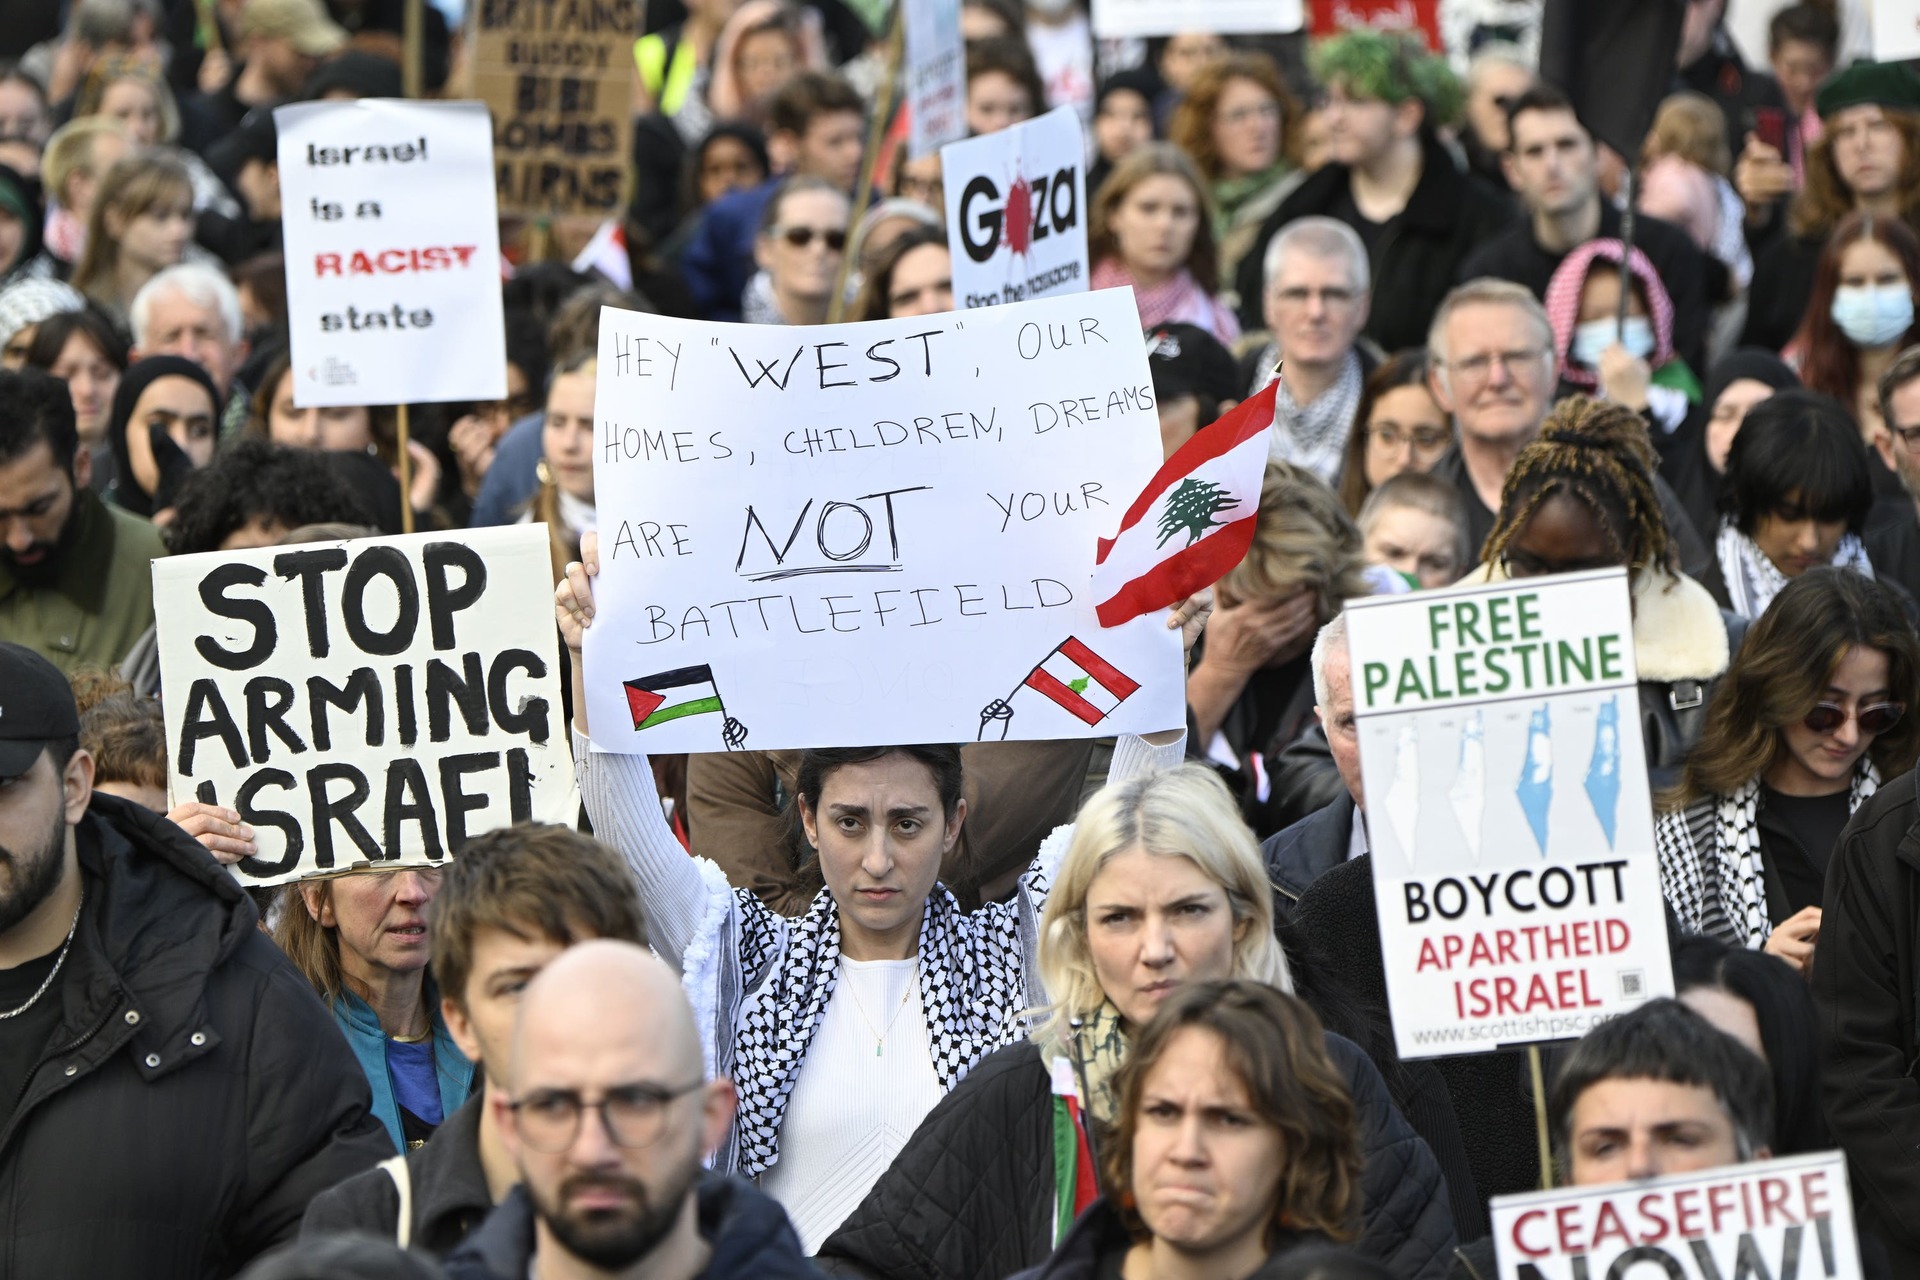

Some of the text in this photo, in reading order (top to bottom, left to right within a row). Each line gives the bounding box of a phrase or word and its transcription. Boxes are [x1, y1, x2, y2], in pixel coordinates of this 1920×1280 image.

[307, 137, 427, 167] Israel
[493, 120, 616, 155] OMBS
[311, 198, 382, 221] is a
[315, 246, 476, 277] RACIST
[1003, 281, 1026, 304] the
[320, 304, 434, 332] state
[614, 331, 681, 391] HEY
[1017, 317, 1109, 360] OUR
[605, 385, 1156, 466] HOMES, CHILDREN, DREAMS
[612, 481, 1110, 573] ARE NOT YOUR
[193, 541, 488, 671] STOP
[636, 577, 1073, 645] BATTLEFIELD
[1428, 593, 1543, 650] FREE
[1363, 633, 1624, 707] PALESTINE
[177, 648, 550, 777] ARMING
[196, 747, 535, 878] SRAE
[1404, 860, 1628, 925] BOYCOTT
[1416, 918, 1631, 974] APARTHEID
[1453, 968, 1602, 1020] ISRAEL
[1511, 1171, 1834, 1258] CEASEFIRE
